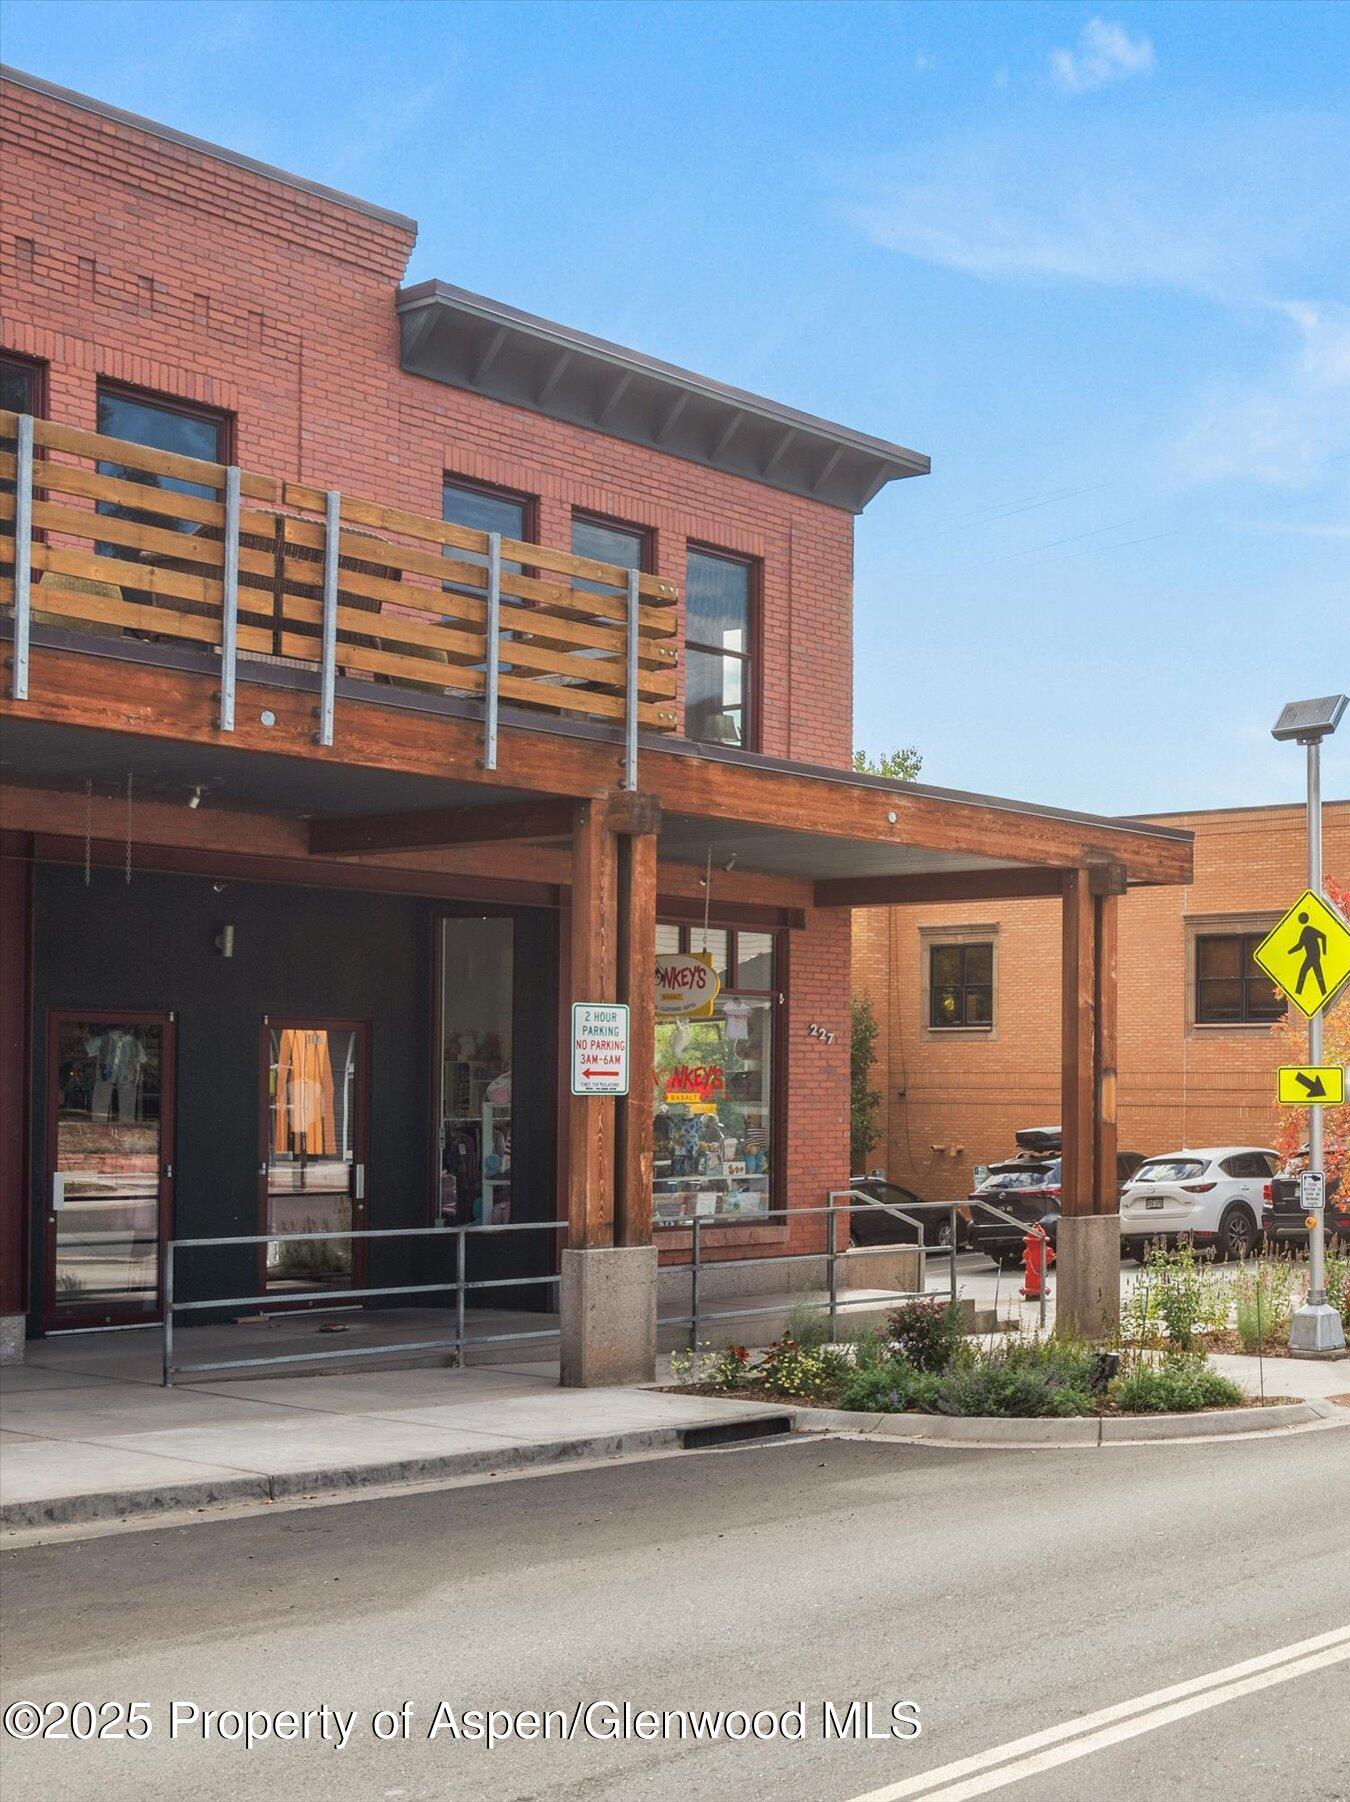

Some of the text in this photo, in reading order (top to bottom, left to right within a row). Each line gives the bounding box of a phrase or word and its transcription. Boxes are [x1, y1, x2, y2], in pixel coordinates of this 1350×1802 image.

[584, 1011, 618, 1022] 2 HOUR
[582, 1026, 619, 1037] PARKING
[809, 1023, 835, 1045] 227
[576, 1040, 625, 1051] NO PARKING
[580, 1054, 621, 1065] 3AM-6AM
